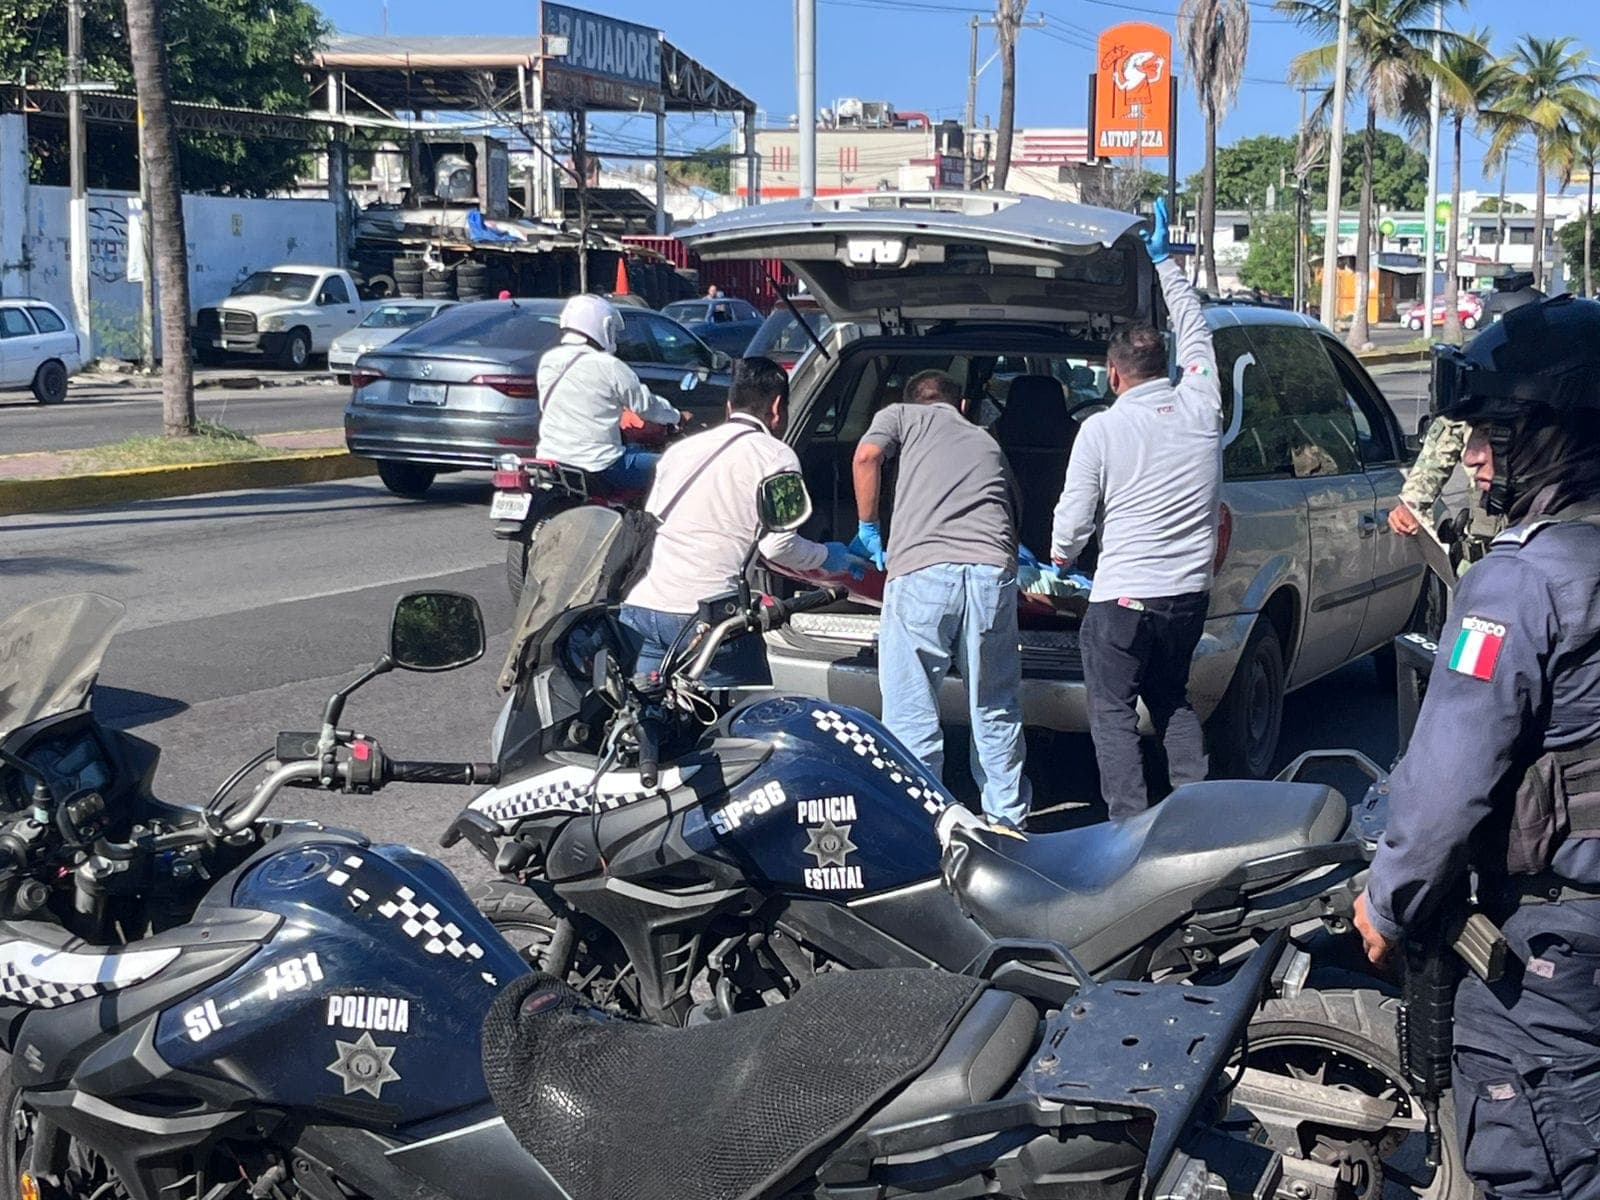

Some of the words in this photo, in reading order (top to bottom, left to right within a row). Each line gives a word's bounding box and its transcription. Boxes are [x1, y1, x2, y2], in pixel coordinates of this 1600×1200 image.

[1100, 130, 1163, 147] AUTOPZZA
[710, 779, 786, 836] SP-36
[797, 795, 857, 823] POLICIA
[804, 866, 864, 890] ESTATAL
[327, 995, 409, 1033] POLICIA
